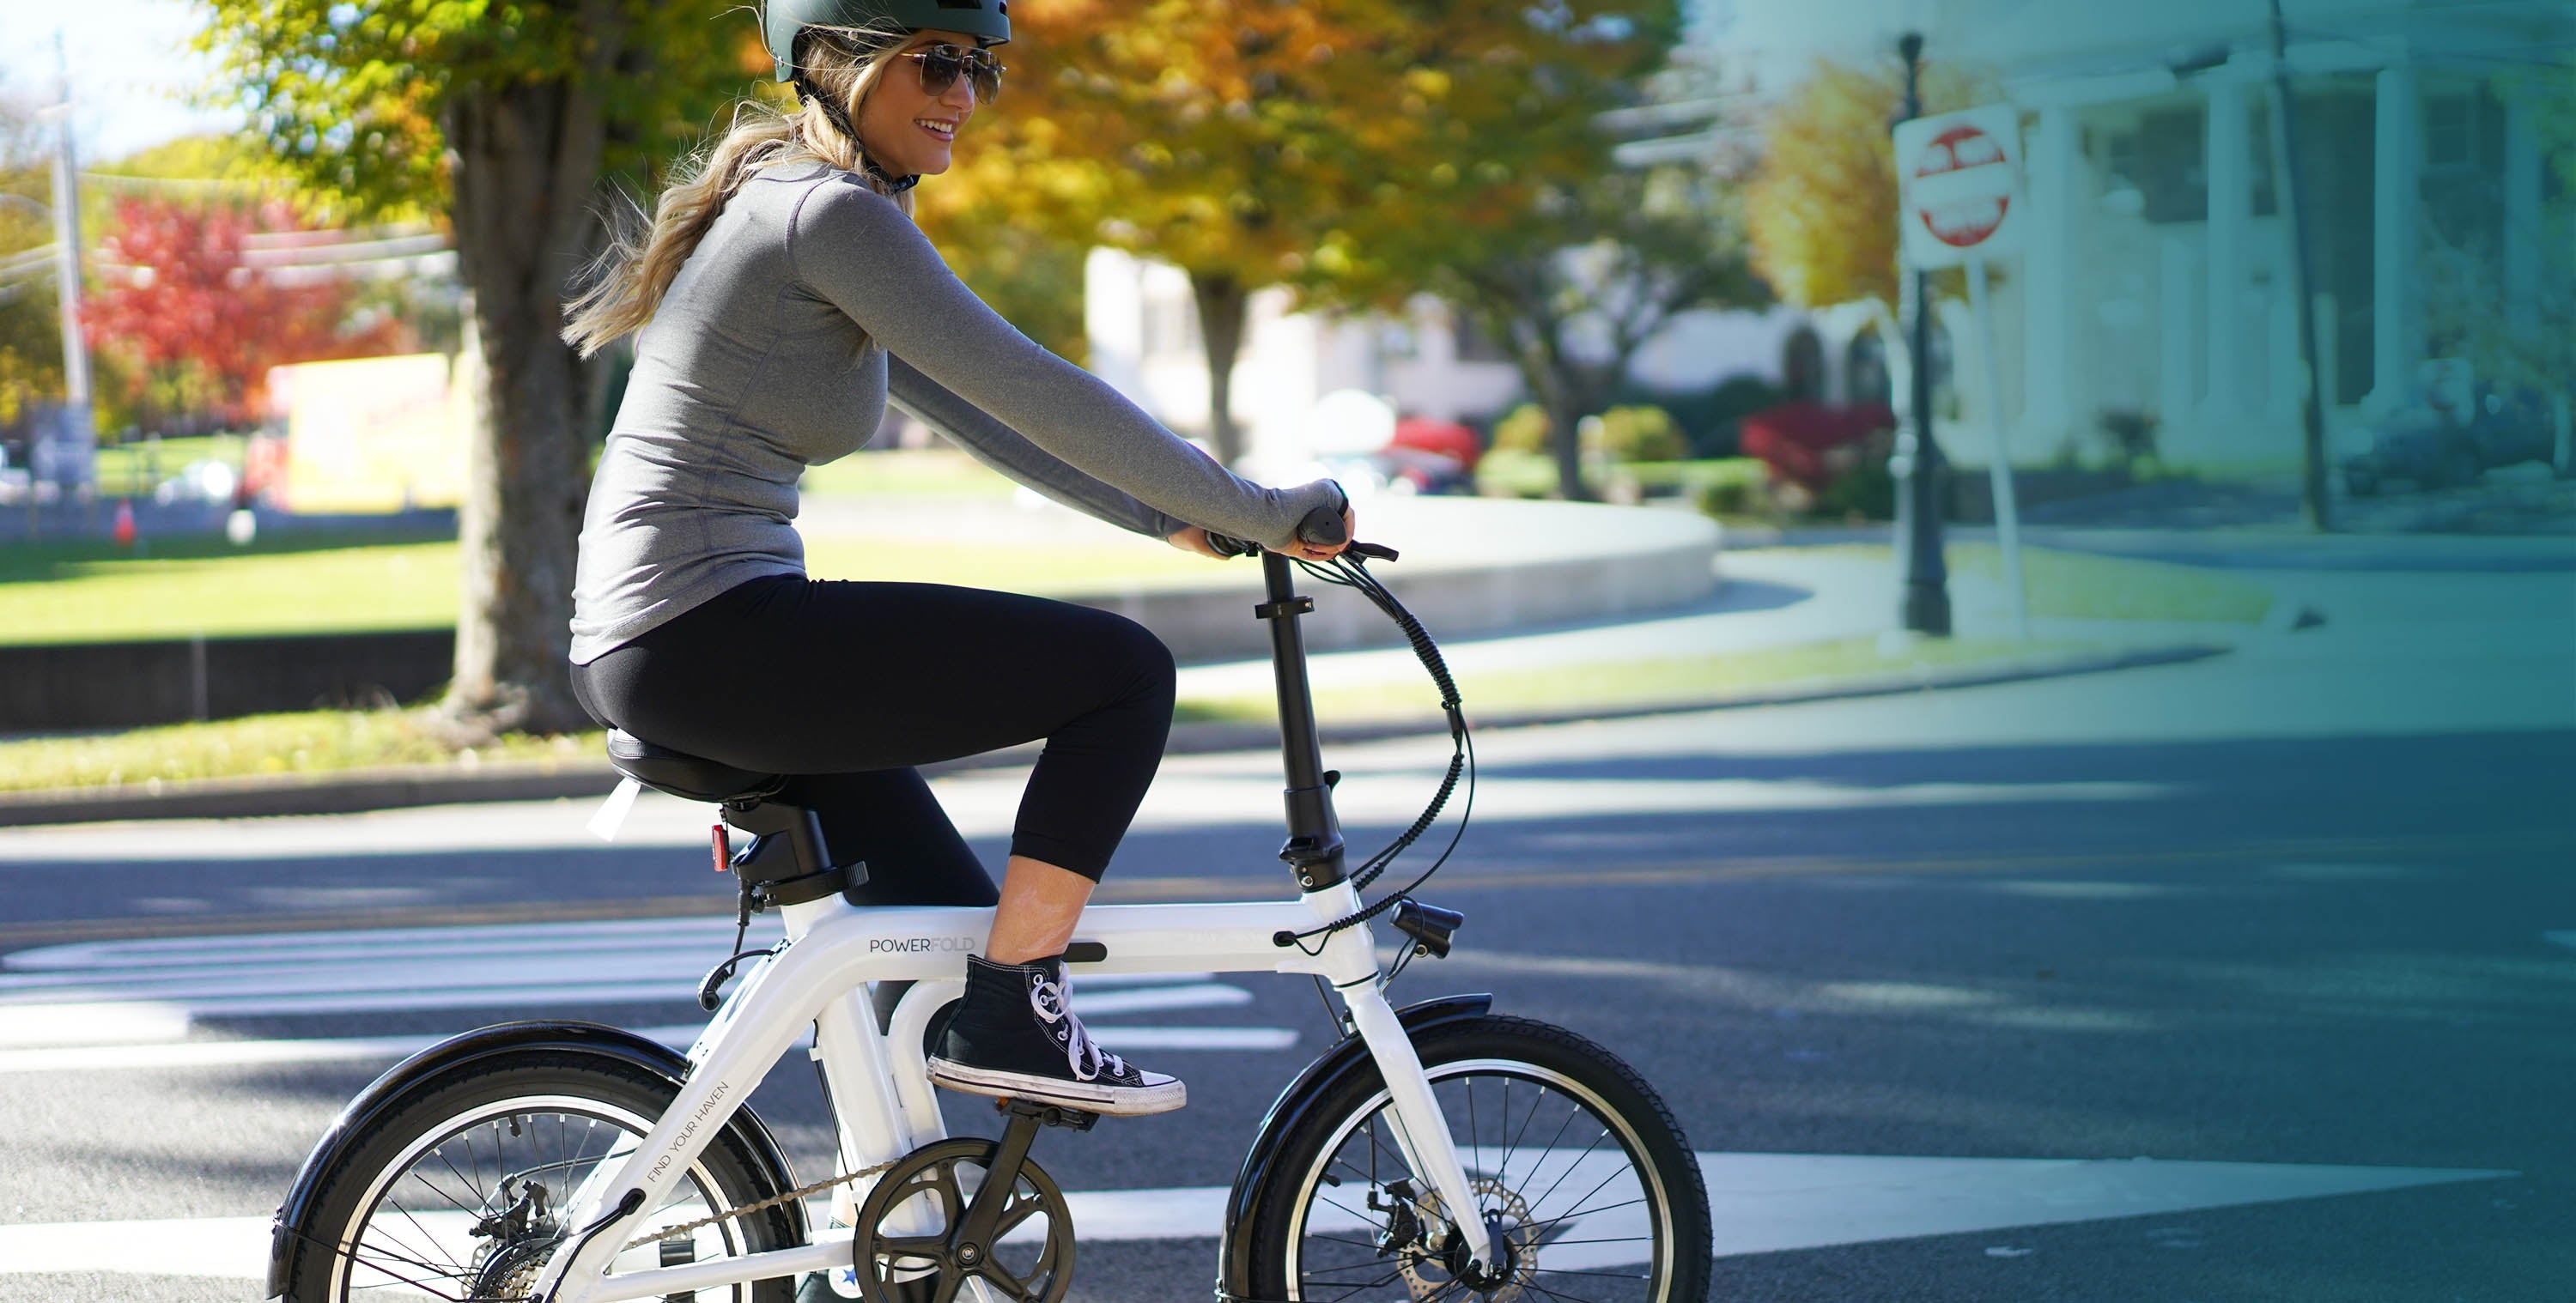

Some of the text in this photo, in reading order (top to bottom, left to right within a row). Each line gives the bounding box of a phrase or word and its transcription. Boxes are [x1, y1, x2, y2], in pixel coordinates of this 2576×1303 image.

[870, 937, 975, 953] POWERFOLD
[647, 1081, 730, 1182] FIND YOUR HAVEN
